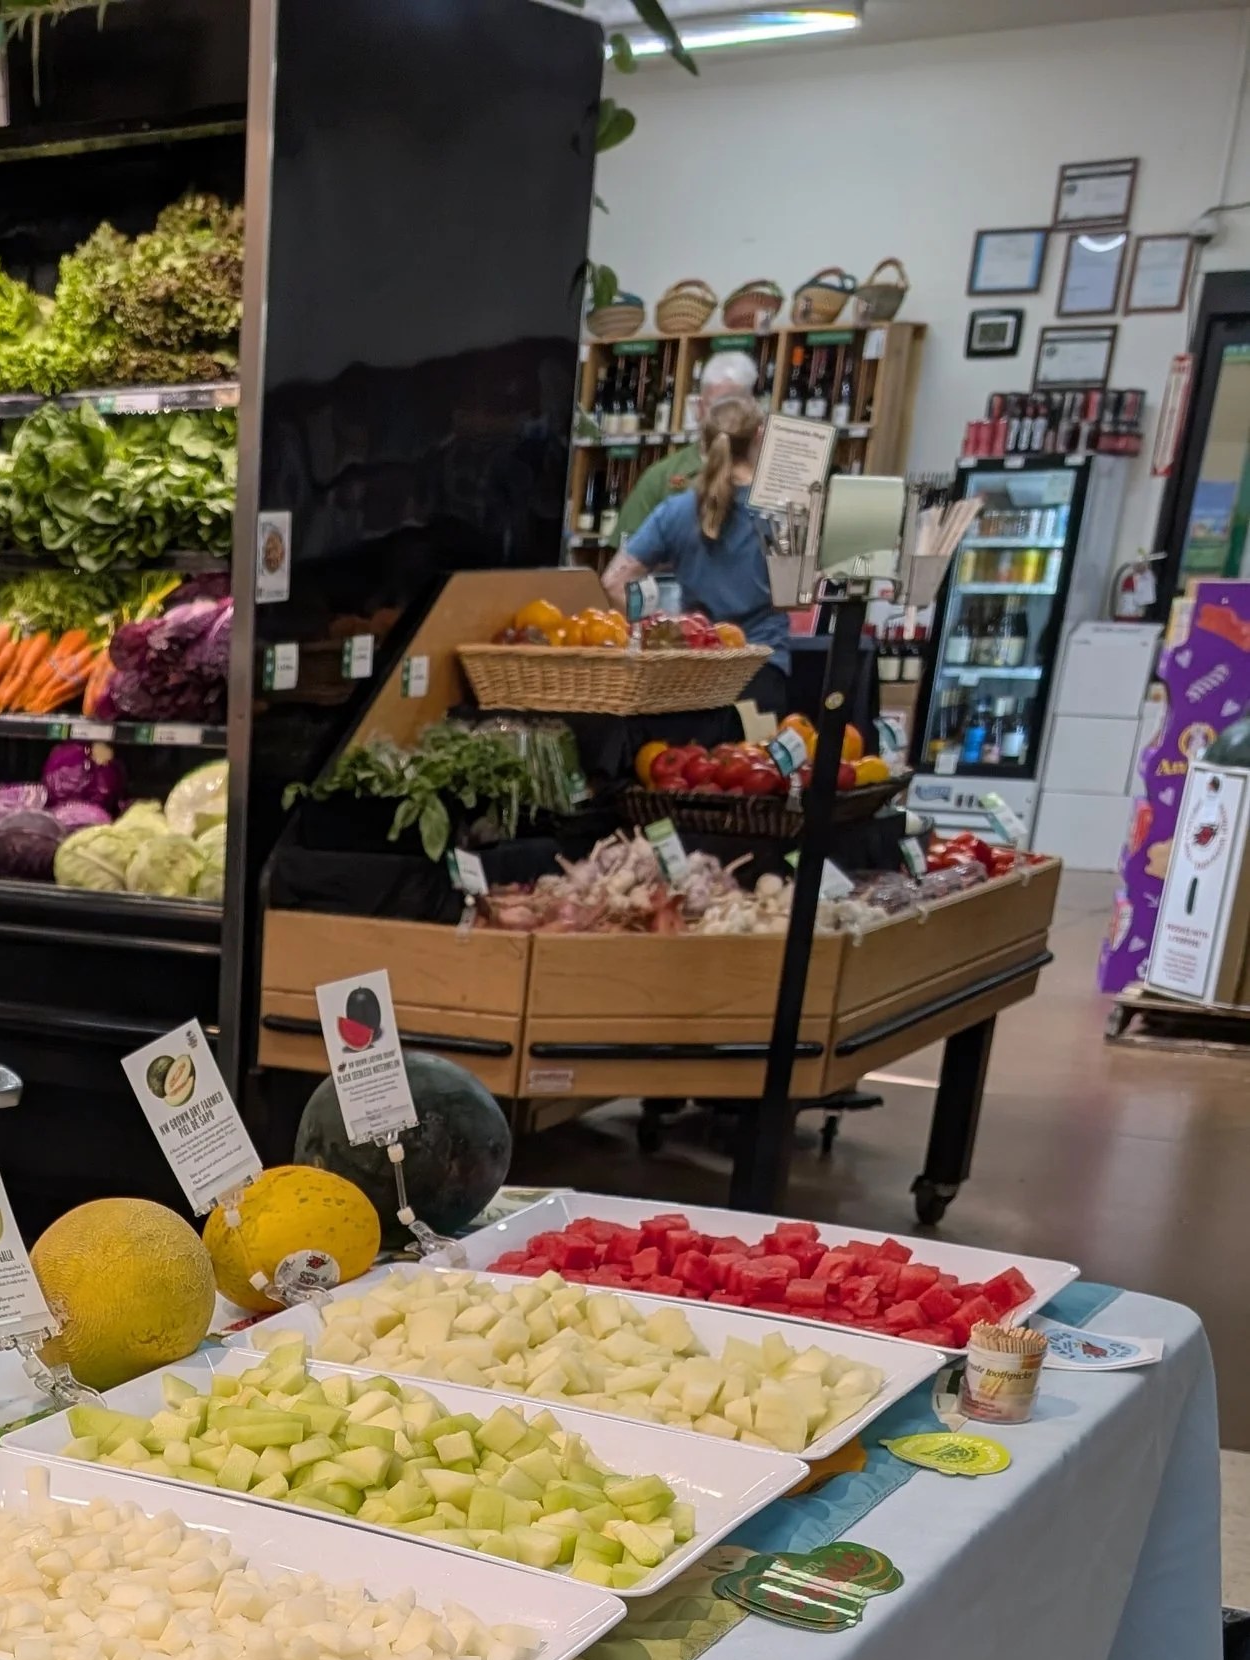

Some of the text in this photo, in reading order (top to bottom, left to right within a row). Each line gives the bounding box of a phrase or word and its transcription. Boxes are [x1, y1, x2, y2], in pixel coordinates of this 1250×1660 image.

[168, 1110, 190, 1130] GROWN
[200, 1090, 223, 1111] FARMED
[986, 1368, 1033, 1383] toothpicks
